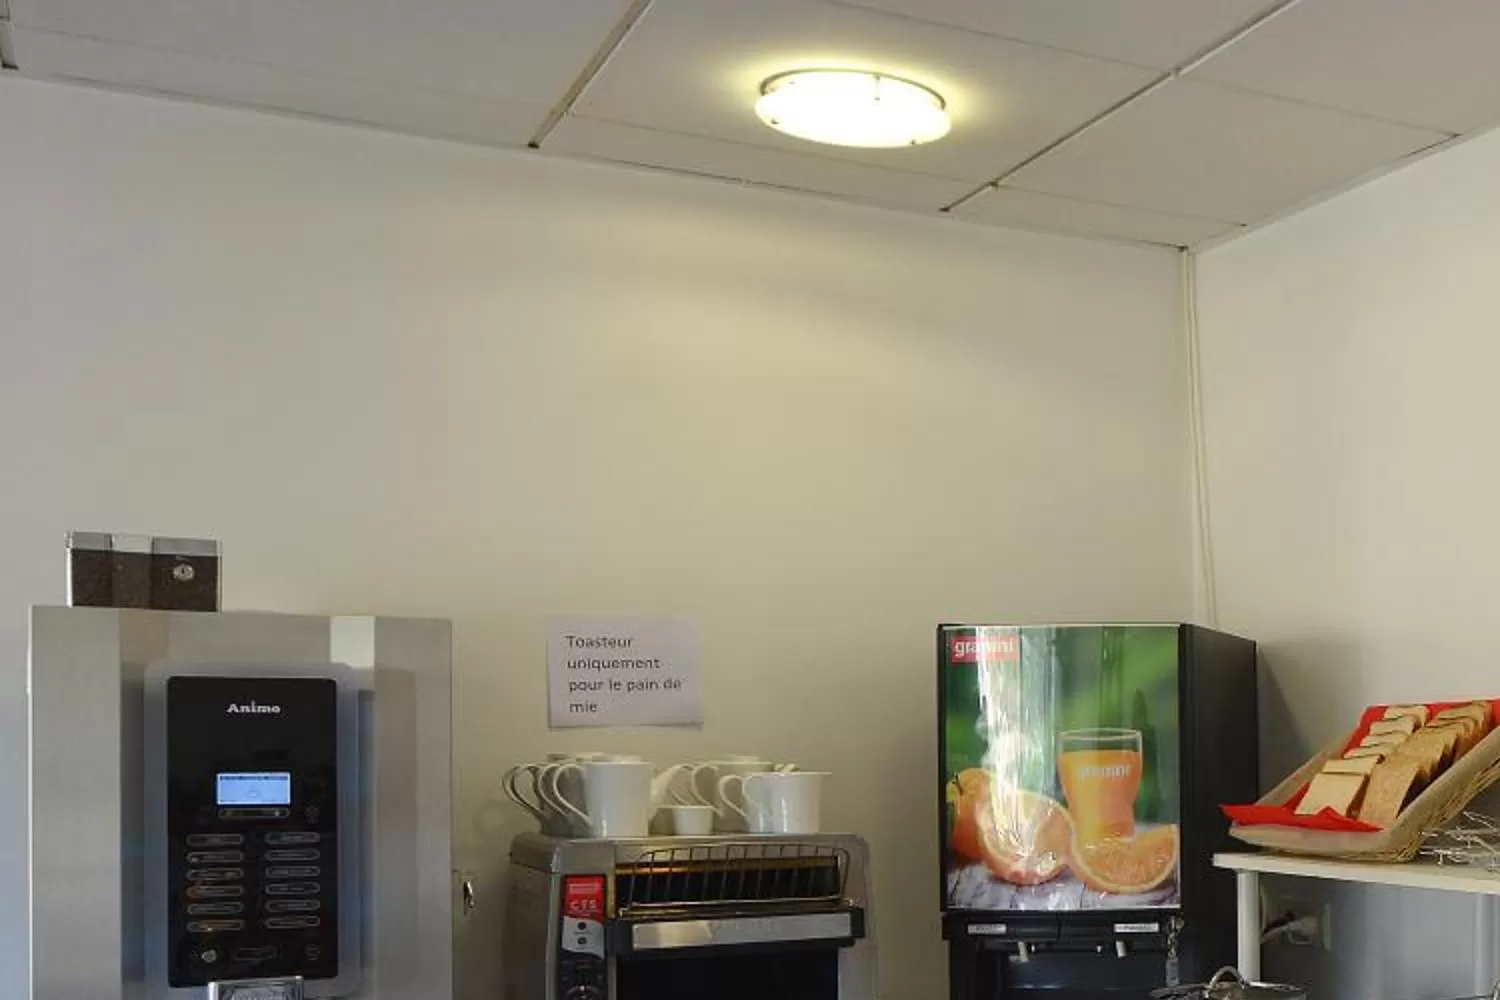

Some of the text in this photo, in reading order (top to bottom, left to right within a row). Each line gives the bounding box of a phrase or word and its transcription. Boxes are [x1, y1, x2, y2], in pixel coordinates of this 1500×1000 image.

[565, 635, 633, 648] Toasteur
[567, 656, 661, 671] uniquement
[567, 676, 681, 694] pour le pain de
[226, 700, 281, 714] Animo
[569, 700, 598, 712] mie
